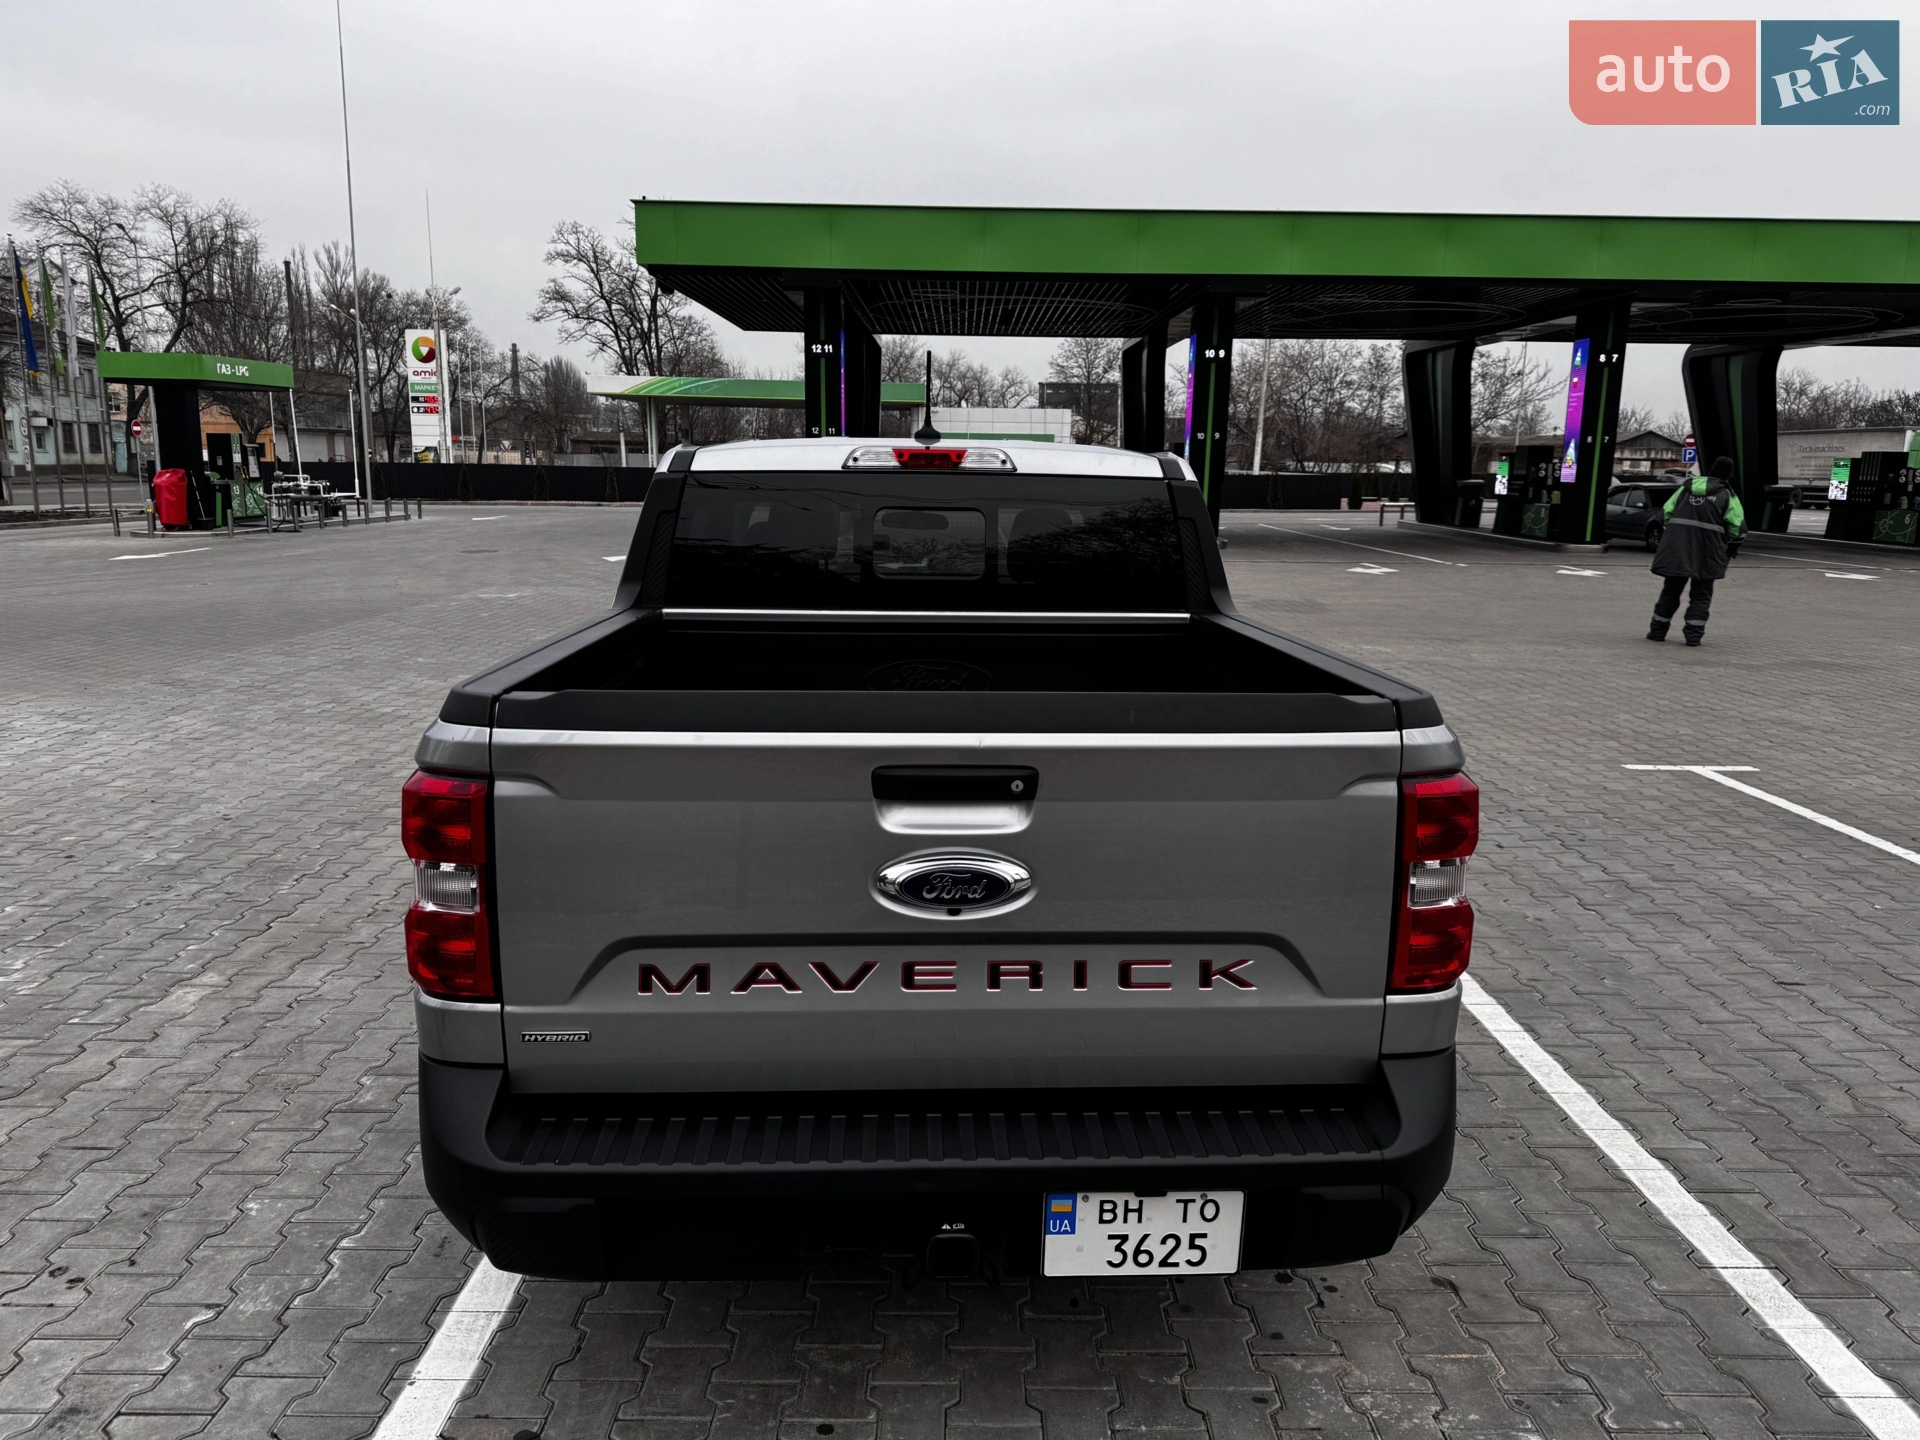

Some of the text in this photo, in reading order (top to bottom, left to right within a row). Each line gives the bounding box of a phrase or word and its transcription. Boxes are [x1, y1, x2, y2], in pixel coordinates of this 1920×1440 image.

[811, 344, 833, 353] 12 11
[1204, 349, 1225, 358] 10 9
[1599, 353, 1618, 363] 8 7
[811, 427, 836, 435] 12 11
[1196, 432, 1220, 440] 10 9
[1798, 443, 1845, 454] Tech-machines
[1685, 449, 1695, 461] P
[233, 485, 240, 495] 13
[256, 486, 264, 495] 14
[1904, 514, 1911, 524] 6
[922, 872, 988, 899] Ford
[637, 958, 1259, 996] MAVERICK
[523, 1034, 586, 1042] HYBRID
[1098, 1198, 1221, 1225] BH TO
[1049, 1219, 1072, 1233] UA
[1106, 1233, 1208, 1269] 3625
